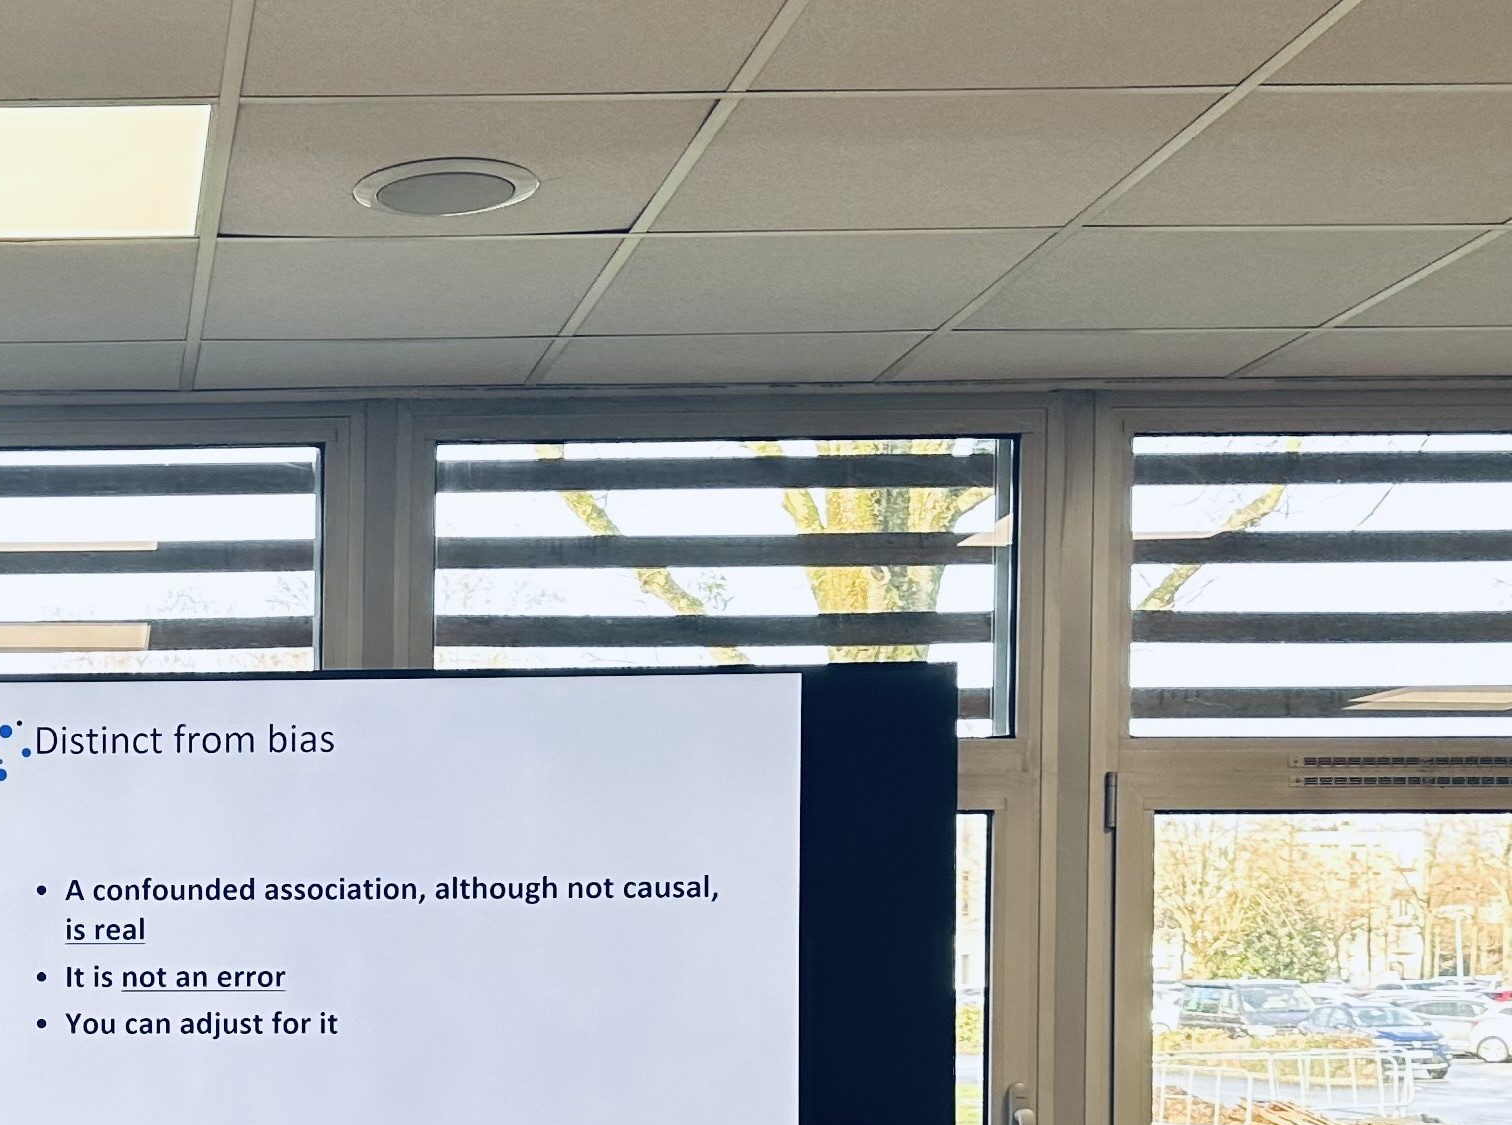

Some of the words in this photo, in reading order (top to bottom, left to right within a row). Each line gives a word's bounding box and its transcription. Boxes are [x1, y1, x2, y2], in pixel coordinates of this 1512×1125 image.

[36, 724, 163, 755] Distinct
[174, 723, 255, 754] from
[269, 723, 335, 754] bias
[64, 879, 85, 901] A
[93, 877, 255, 902] confounded
[264, 876, 426, 905] association,
[435, 875, 558, 905] although
[568, 878, 615, 899] not
[623, 874, 719, 903] causal,
[66, 917, 86, 941] is
[95, 917, 145, 941] real
[66, 966, 85, 988] It
[93, 965, 113, 988] is
[122, 967, 167, 988] not
[176, 970, 208, 988] an
[217, 970, 287, 988] error
[64, 1012, 116, 1035] You
[125, 1017, 171, 1035] can
[180, 1011, 264, 1040] adjust
[271, 1010, 312, 1035] for
[320, 1011, 339, 1035] it
